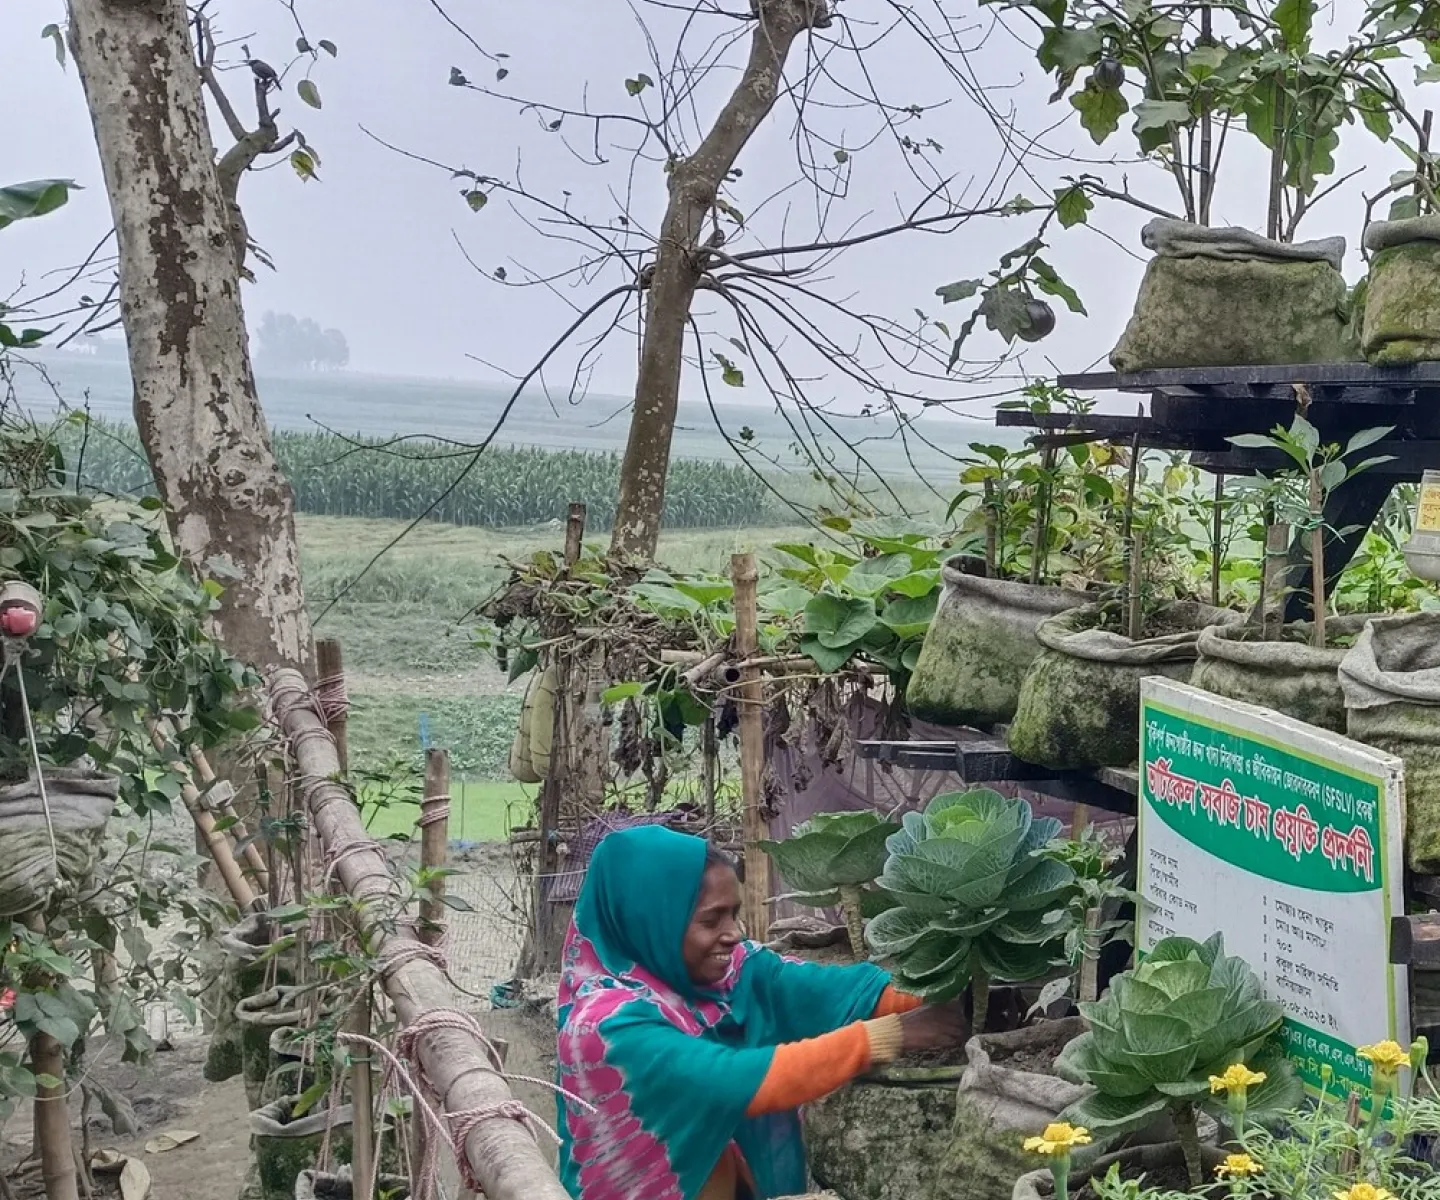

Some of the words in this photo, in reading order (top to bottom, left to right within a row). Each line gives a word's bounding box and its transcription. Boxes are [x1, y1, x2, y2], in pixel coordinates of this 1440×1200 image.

[1200, 779, 1241, 827] সবজি
[1244, 795, 1270, 841] চাষ
[1273, 804, 1318, 860] প্রযুক্তি
[1322, 825, 1375, 883] প্রদর্শনী
[1322, 781, 1355, 820] (SFSLV)
